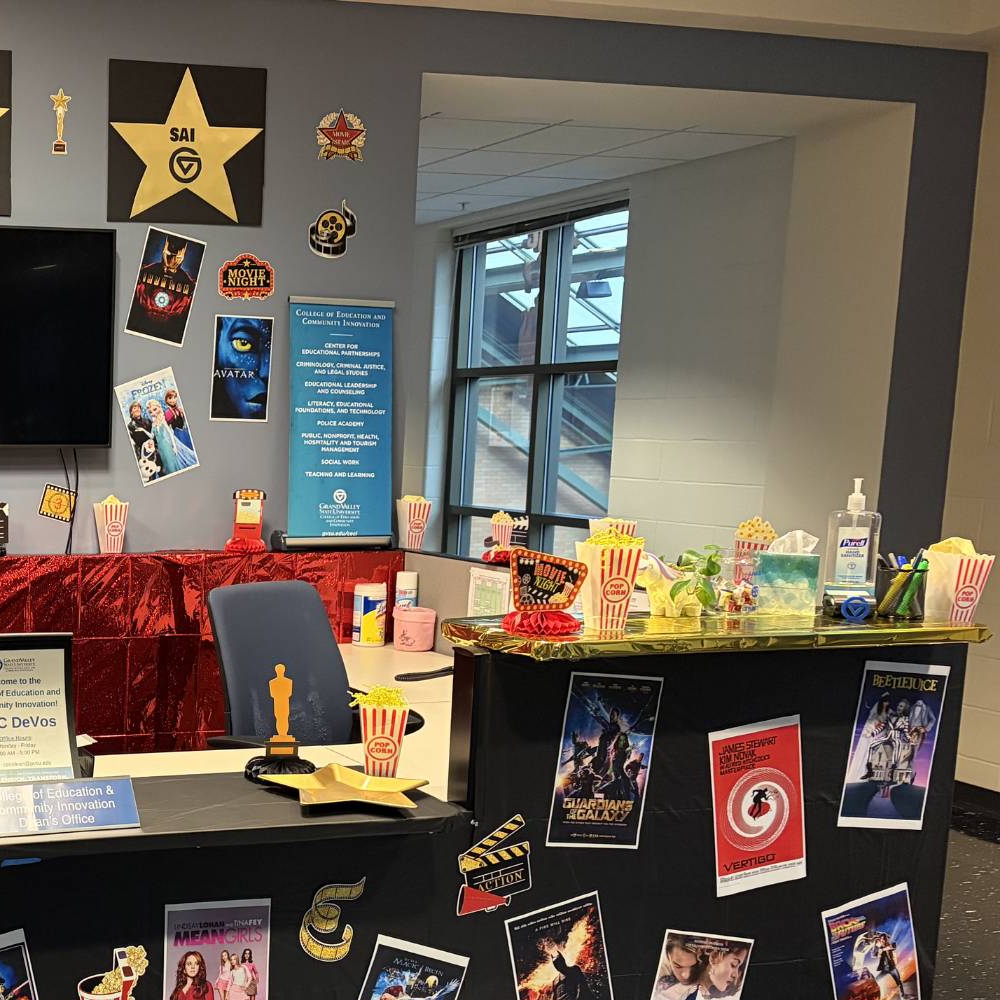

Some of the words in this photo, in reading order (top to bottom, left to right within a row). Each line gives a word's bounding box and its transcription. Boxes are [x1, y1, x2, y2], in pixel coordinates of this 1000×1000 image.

[170, 127, 195, 143] SAI
[228, 268, 266, 278] MOVIE
[228, 277, 266, 287] NIGHT
[296, 309, 324, 317] COLLEGE
[336, 310, 372, 319] EDUCATION
[302, 318, 340, 326] COMMUNITY
[342, 319, 380, 328] INNOVATION
[213, 369, 255, 379] AVATAR
[131, 378, 166, 399] FROZEN
[534, 563, 567, 584] MOVIE
[534, 574, 560, 593] NIGHT
[29, 677, 41, 685] the
[872, 673, 938, 692] BEETLEJUICE
[5, 689, 45, 697] Education
[46, 688, 61, 696] and
[15, 700, 58, 708] Innovation!
[11, 715, 57, 729] DeVos
[718, 742, 745, 756] JAMES
[745, 736, 777, 750] STEWART
[33, 788, 45, 800] of
[47, 786, 103, 800] Education
[105, 784, 114, 796] &
[57, 798, 116, 811] Innovation
[562, 797, 634, 812] GUARDIANS
[18, 815, 59, 828] Dan's
[61, 814, 95, 826] Office
[576, 808, 630, 822] GALAXY
[723, 853, 777, 872] VERTIGO
[478, 871, 523, 892] ACTION
[173, 928, 225, 947] MEAN
[224, 926, 264, 944] GIRLS
